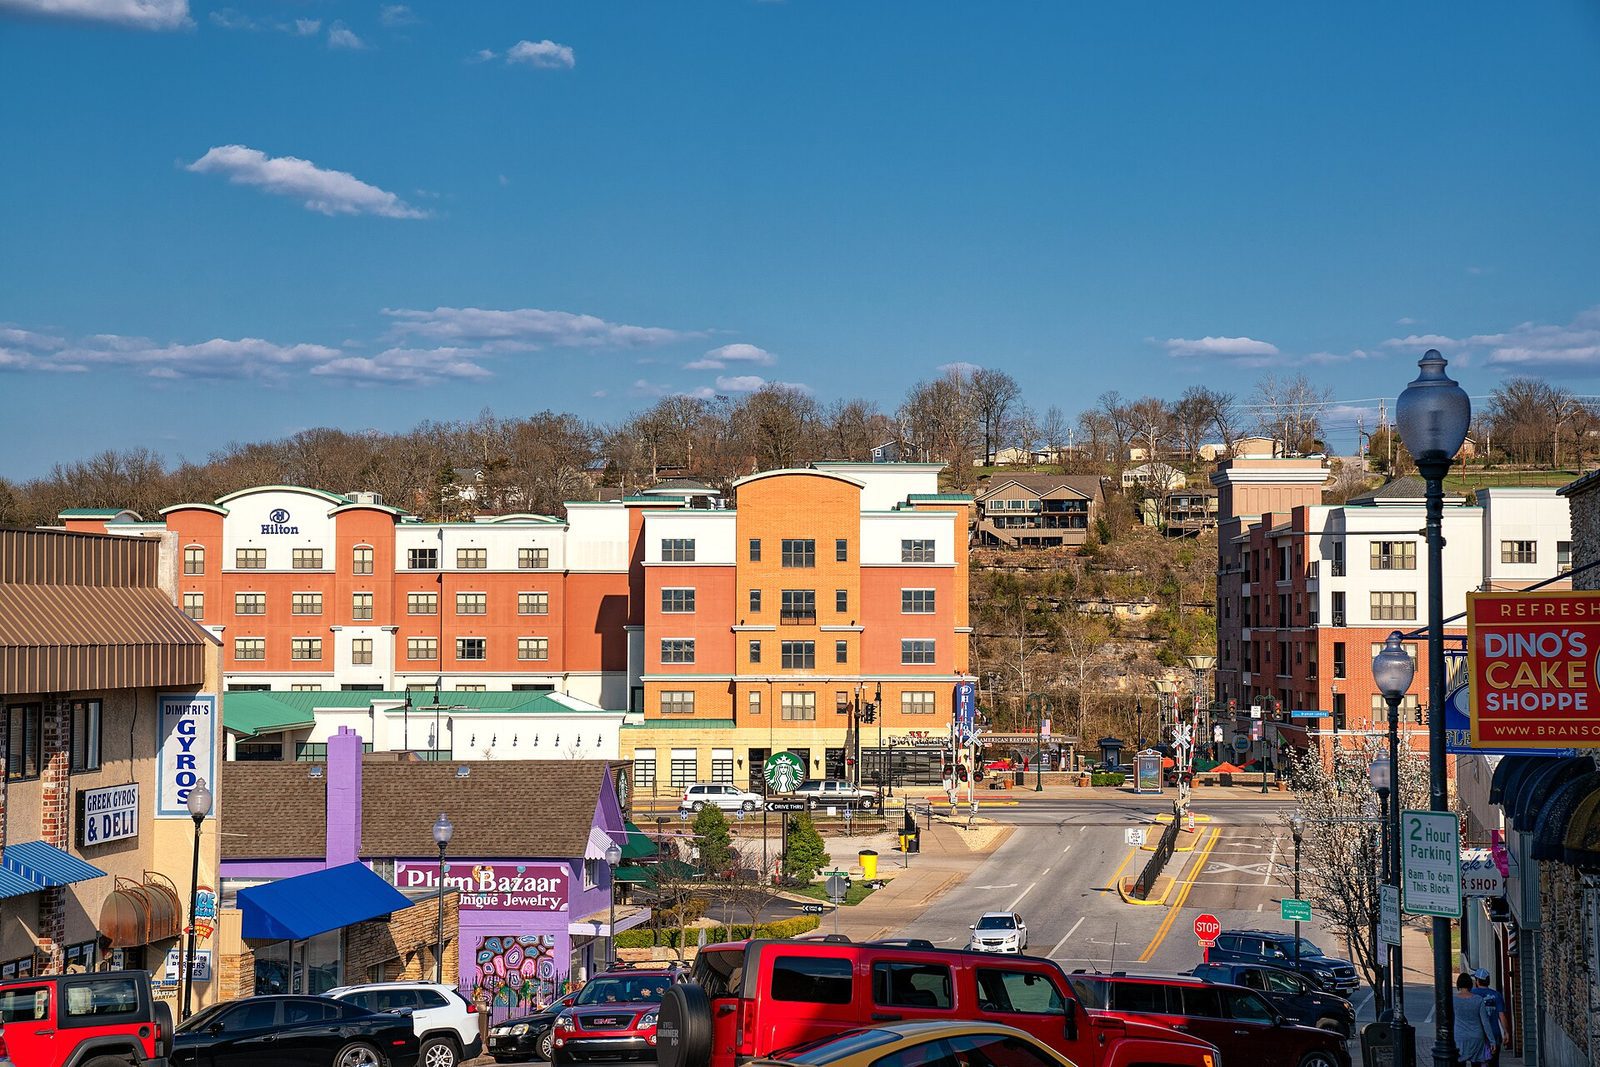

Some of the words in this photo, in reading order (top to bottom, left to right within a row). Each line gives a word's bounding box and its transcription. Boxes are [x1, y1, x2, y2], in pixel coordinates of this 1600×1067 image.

[261, 524, 299, 534] Hilton
[1485, 629, 1587, 658] DINO'S
[1486, 662, 1587, 689] CAKE
[165, 704, 209, 715] DIMITRI'S
[1486, 692, 1588, 711] SHOPPE
[175, 719, 197, 804] GYROS
[87, 793, 111, 811] GREEK
[113, 788, 135, 807] GYROS
[774, 802, 789, 810] DRIVE
[790, 802, 804, 810] THRU
[87, 816, 98, 842] &
[103, 810, 134, 839] DELI
[1410, 818, 1422, 840] 2
[1425, 827, 1451, 843] Hour
[1411, 844, 1451, 865] Parking
[478, 871, 561, 892] Bazaar
[1408, 868, 1424, 879] 8am
[1427, 870, 1434, 880] To
[1438, 872, 1454, 883] 6pm
[1471, 879, 1497, 890] SHOP
[1413, 881, 1427, 892] This
[1430, 883, 1450, 893] Block
[503, 893, 562, 910] Jewelry
[1197, 922, 1218, 933] STOP
[185, 954, 207, 962] Sving
